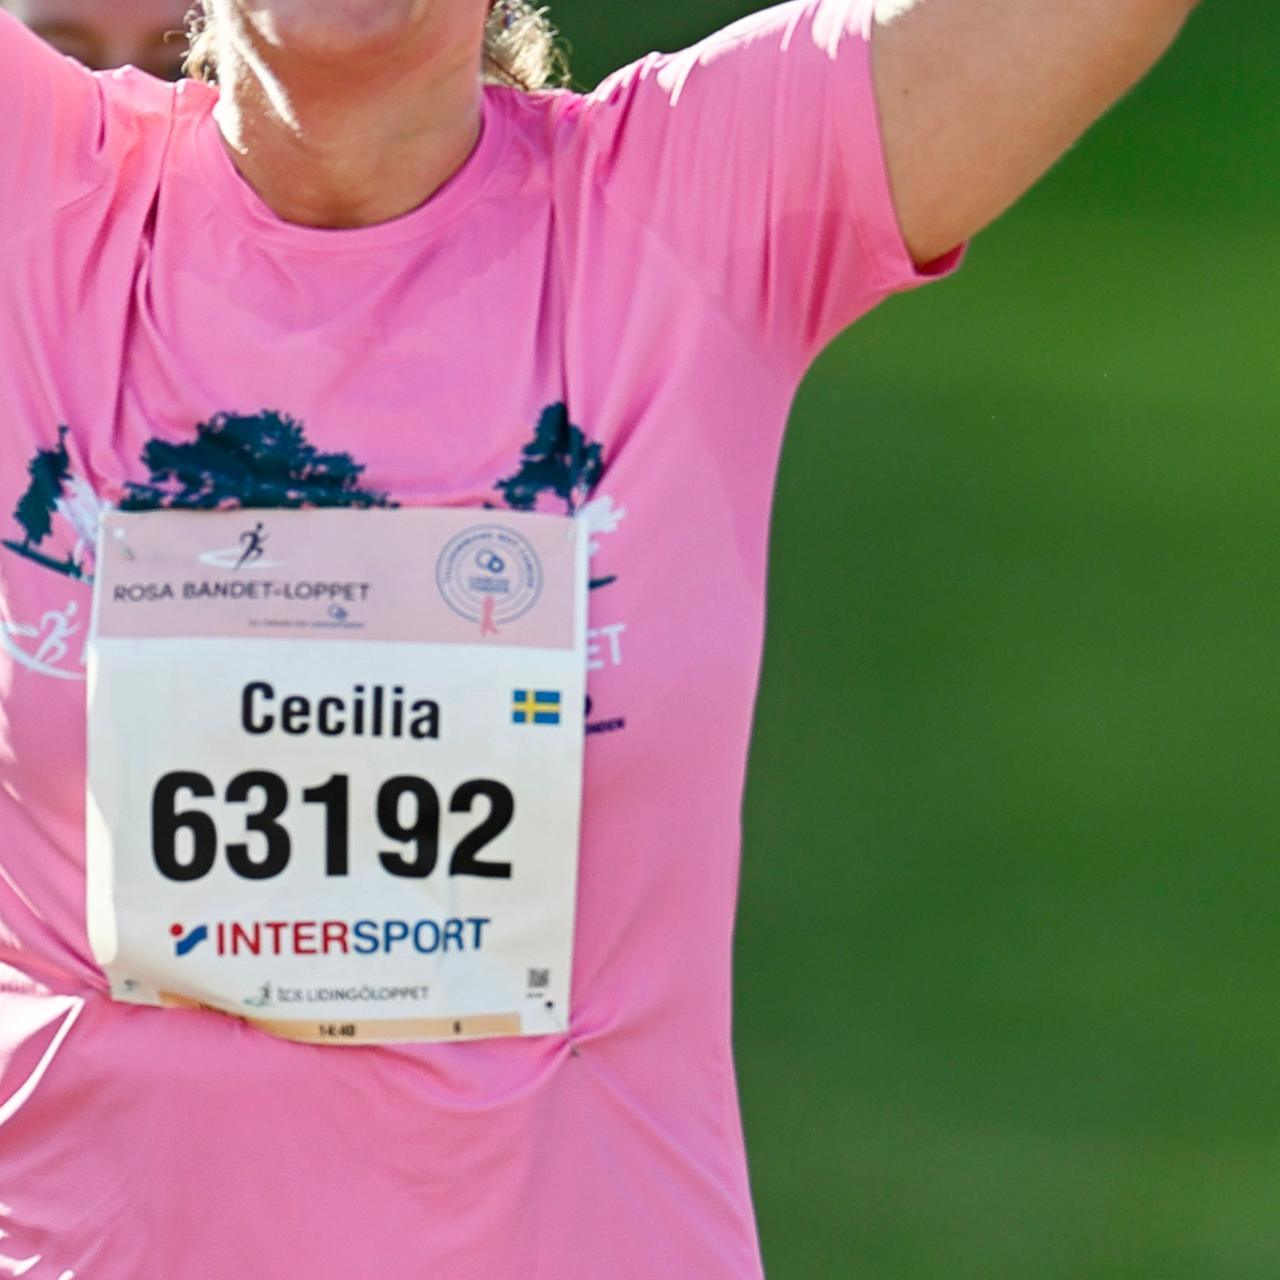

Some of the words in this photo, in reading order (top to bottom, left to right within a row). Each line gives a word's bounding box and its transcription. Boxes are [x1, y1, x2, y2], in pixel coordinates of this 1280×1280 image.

[183, 580, 370, 602] BANDET-LOPPET
[240, 681, 441, 739] Cecilia
[151, 770, 515, 882] 63192
[217, 918, 491, 956] INTERSPORT
